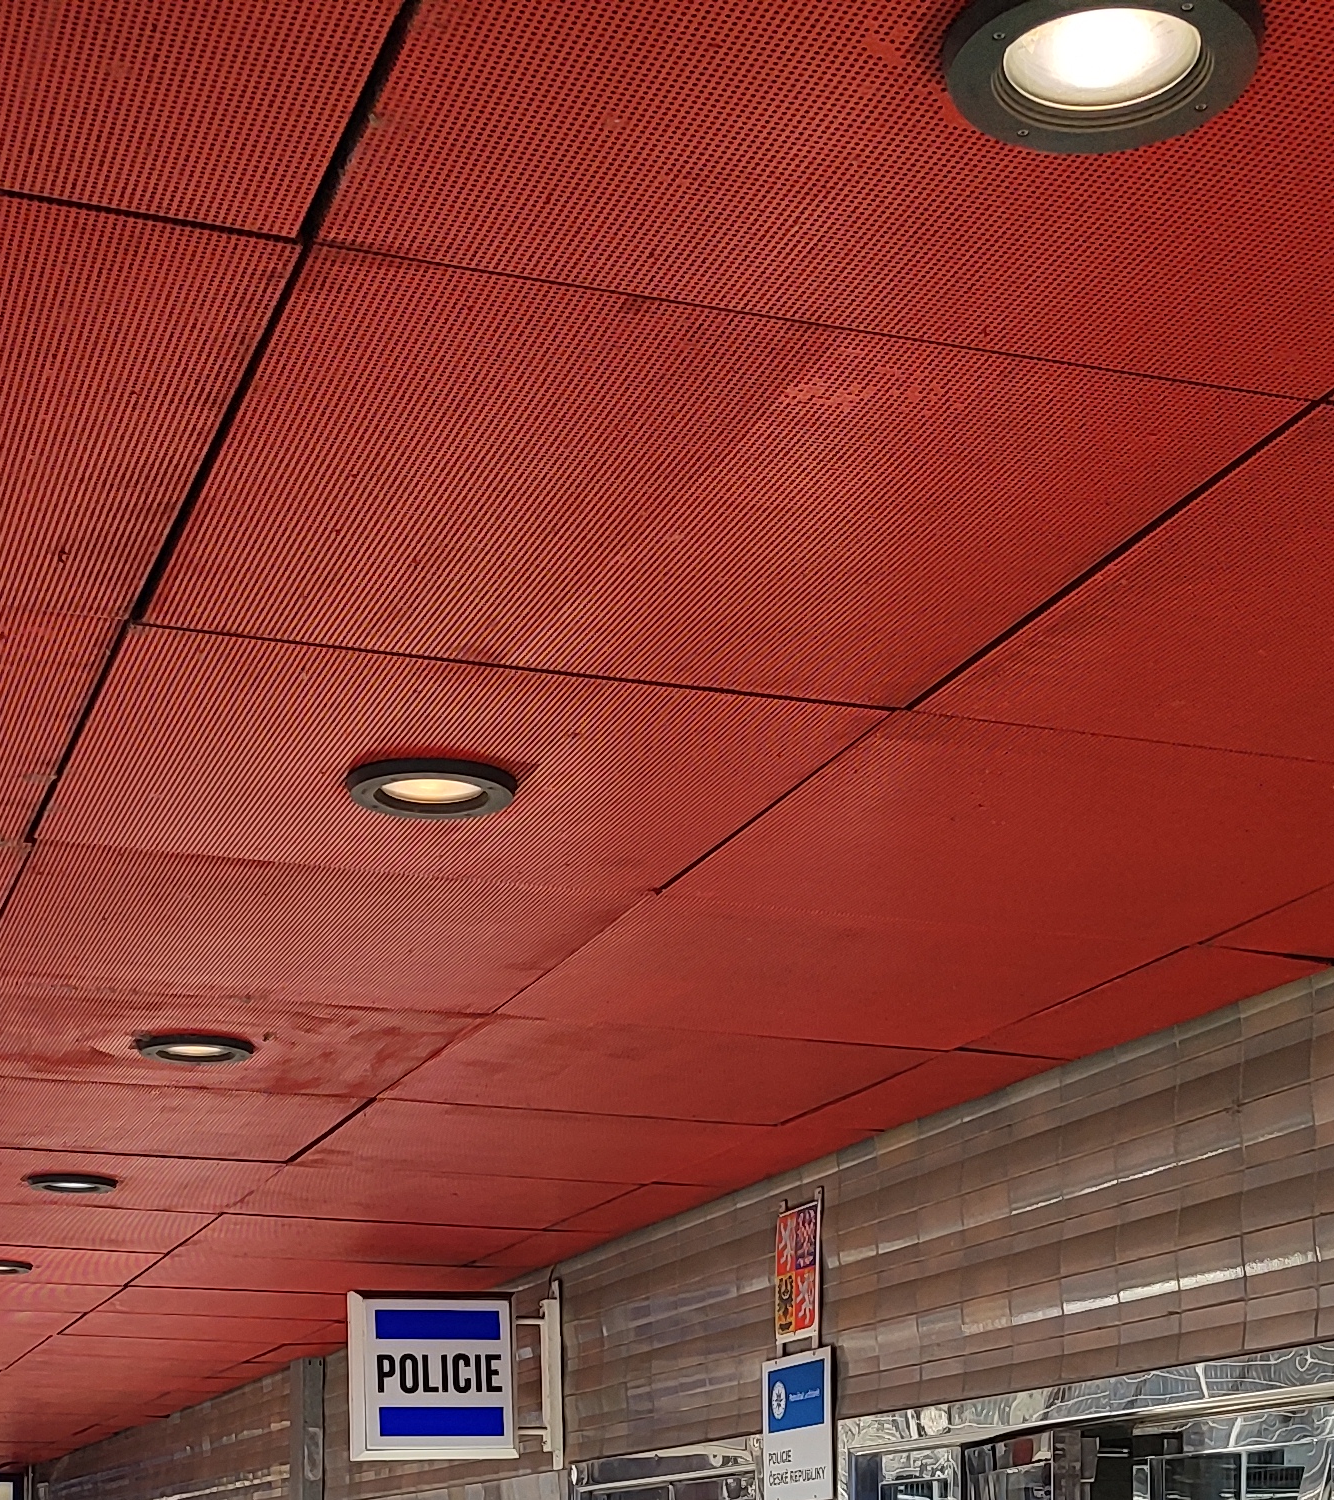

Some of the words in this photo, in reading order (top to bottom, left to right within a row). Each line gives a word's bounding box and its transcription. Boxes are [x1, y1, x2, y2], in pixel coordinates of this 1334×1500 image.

[376, 1353, 503, 1394] POLICIE
[768, 1449, 792, 1466] POLICIE
[768, 1469, 788, 1486] ČESKÉ
[790, 1466, 826, 1484] REPUBLIKY
